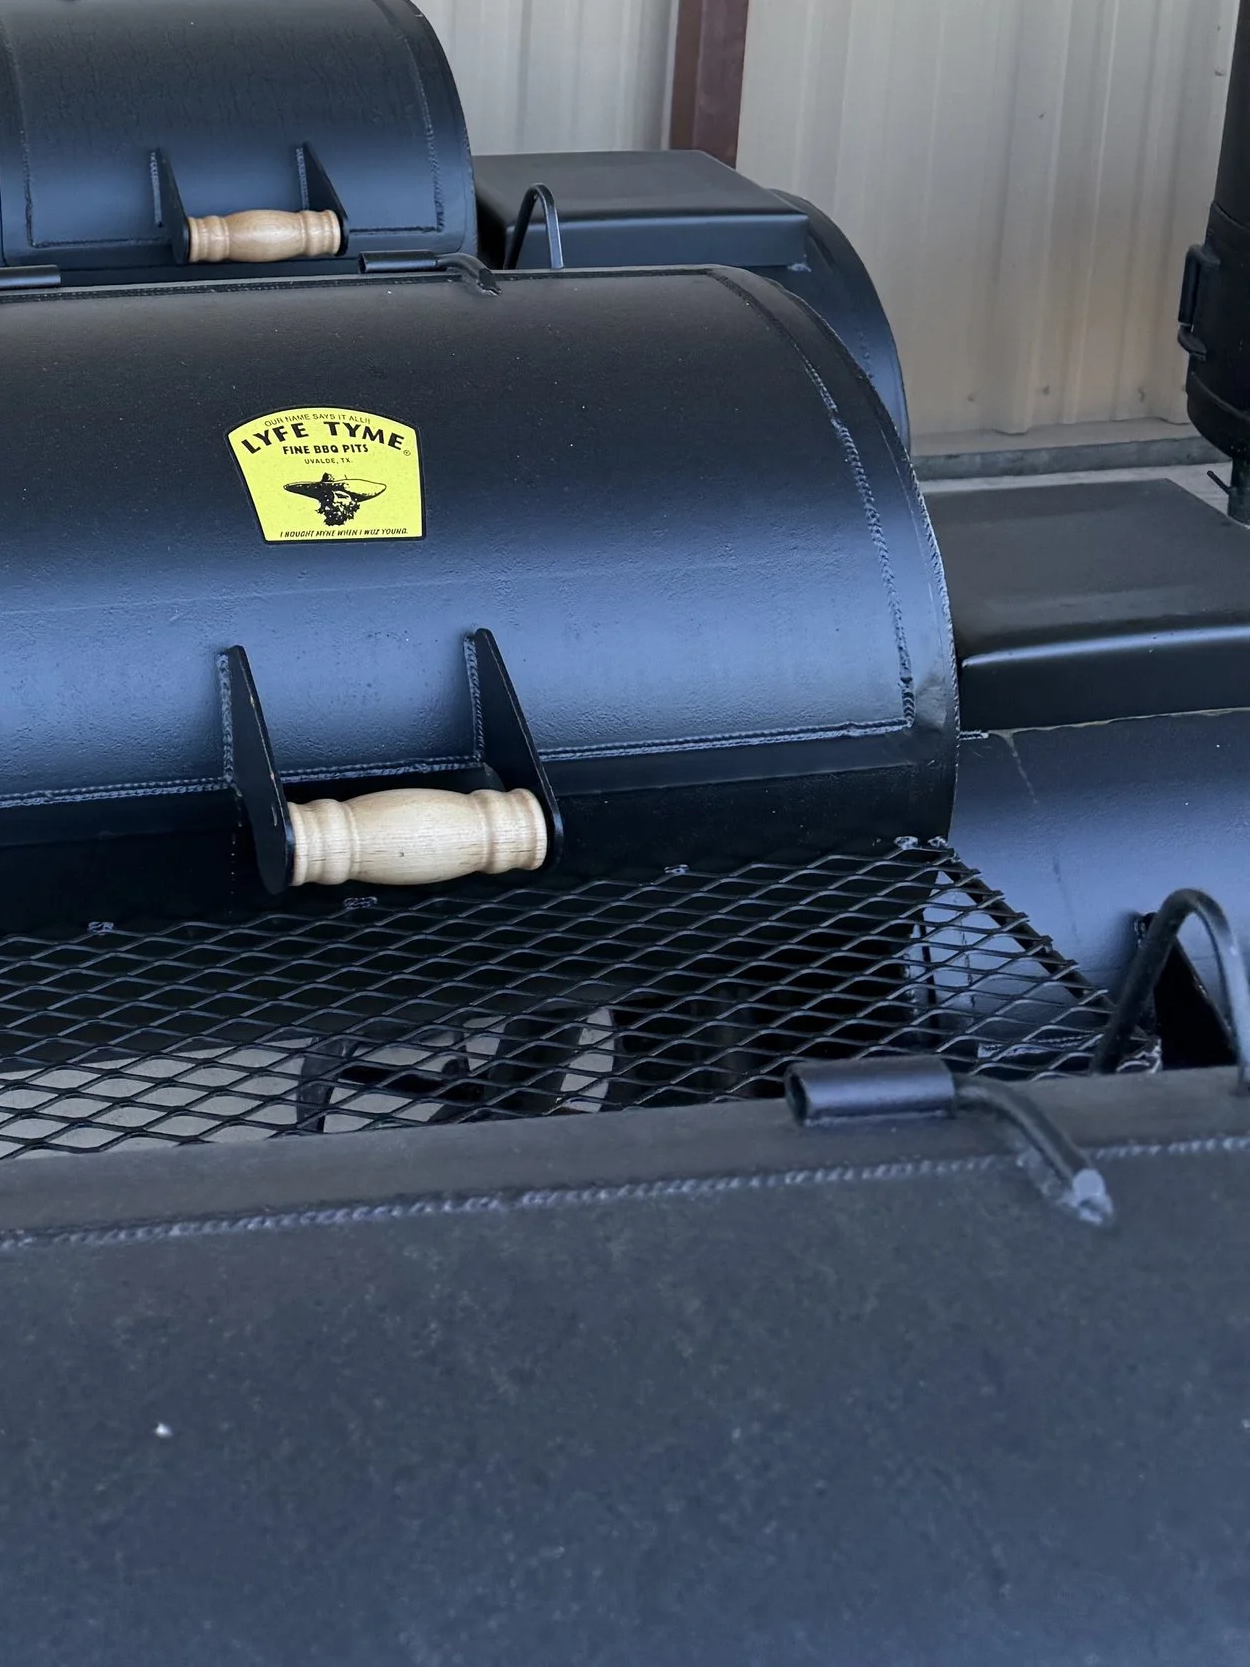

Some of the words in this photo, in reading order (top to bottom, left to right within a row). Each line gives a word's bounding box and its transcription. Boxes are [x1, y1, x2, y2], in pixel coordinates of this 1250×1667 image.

[264, 417, 283, 427] OUR
[285, 413, 311, 423] NAME
[312, 413, 336, 421] SAYS
[338, 413, 347, 421] IT
[241, 422, 309, 455] LYFE
[323, 421, 405, 451] TYME
[282, 445, 311, 455] FINE
[314, 444, 339, 454] BBQ
[343, 443, 369, 453] PITS
